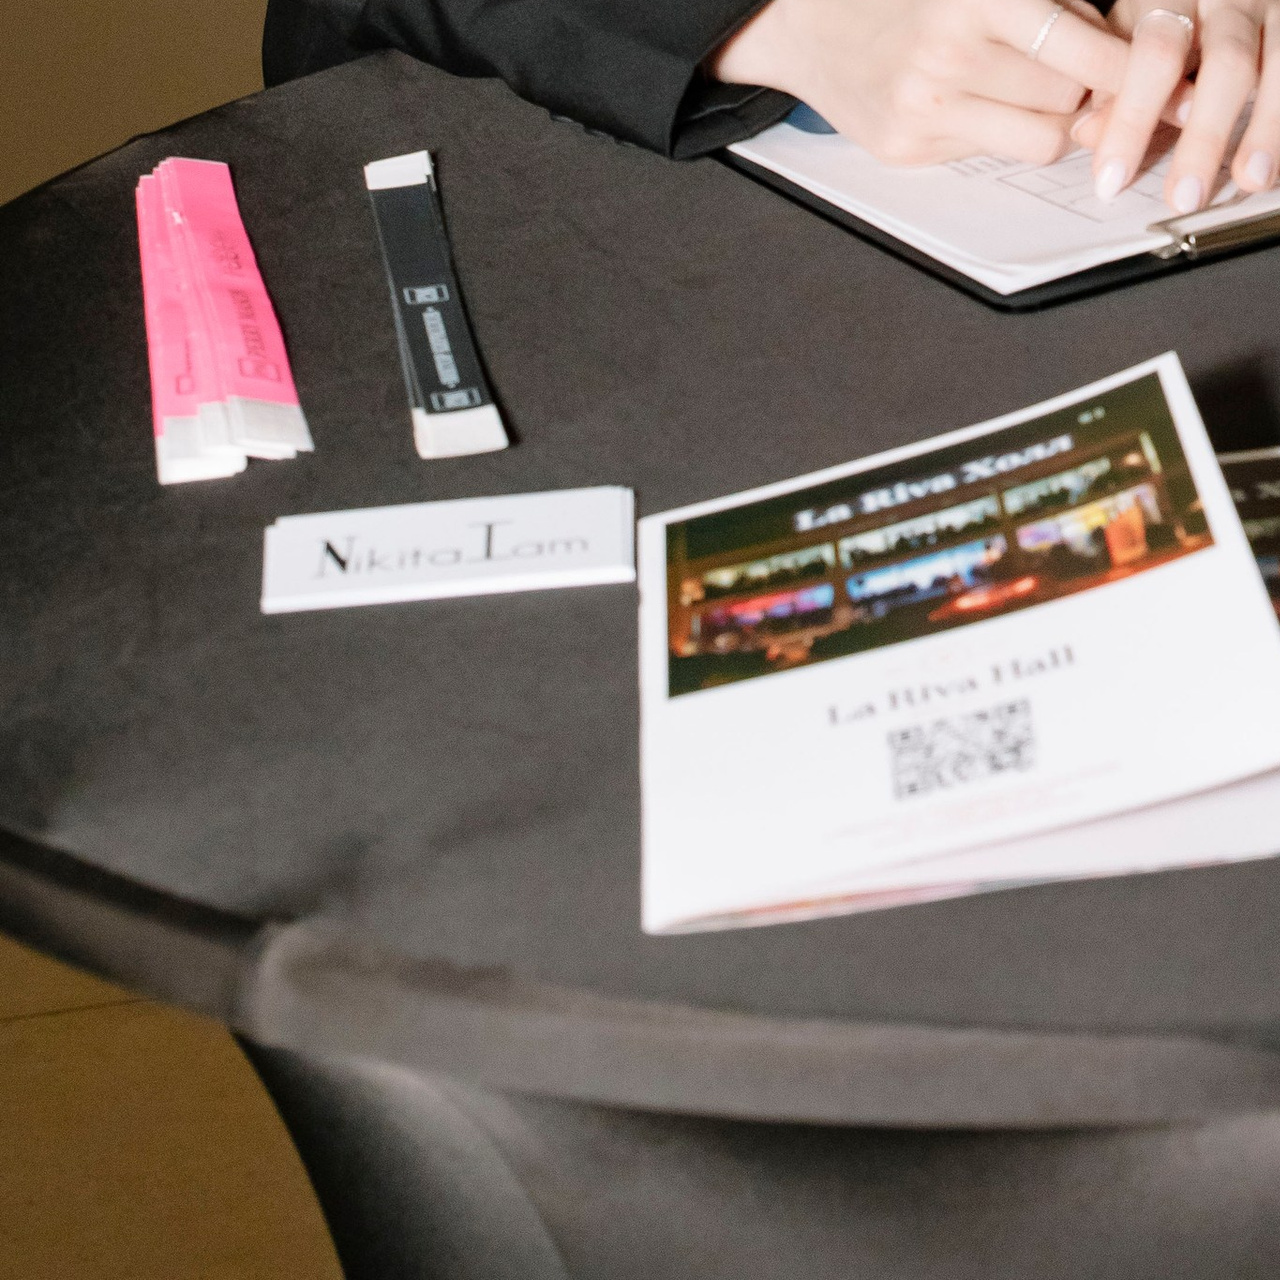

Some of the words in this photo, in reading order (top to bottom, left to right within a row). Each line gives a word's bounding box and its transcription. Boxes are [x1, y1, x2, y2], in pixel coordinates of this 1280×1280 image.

[795, 507, 852, 532] La
[858, 473, 957, 514] Riva
[827, 702, 877, 726] La
[887, 676, 979, 710] Riva
[990, 643, 1075, 684] Hall
